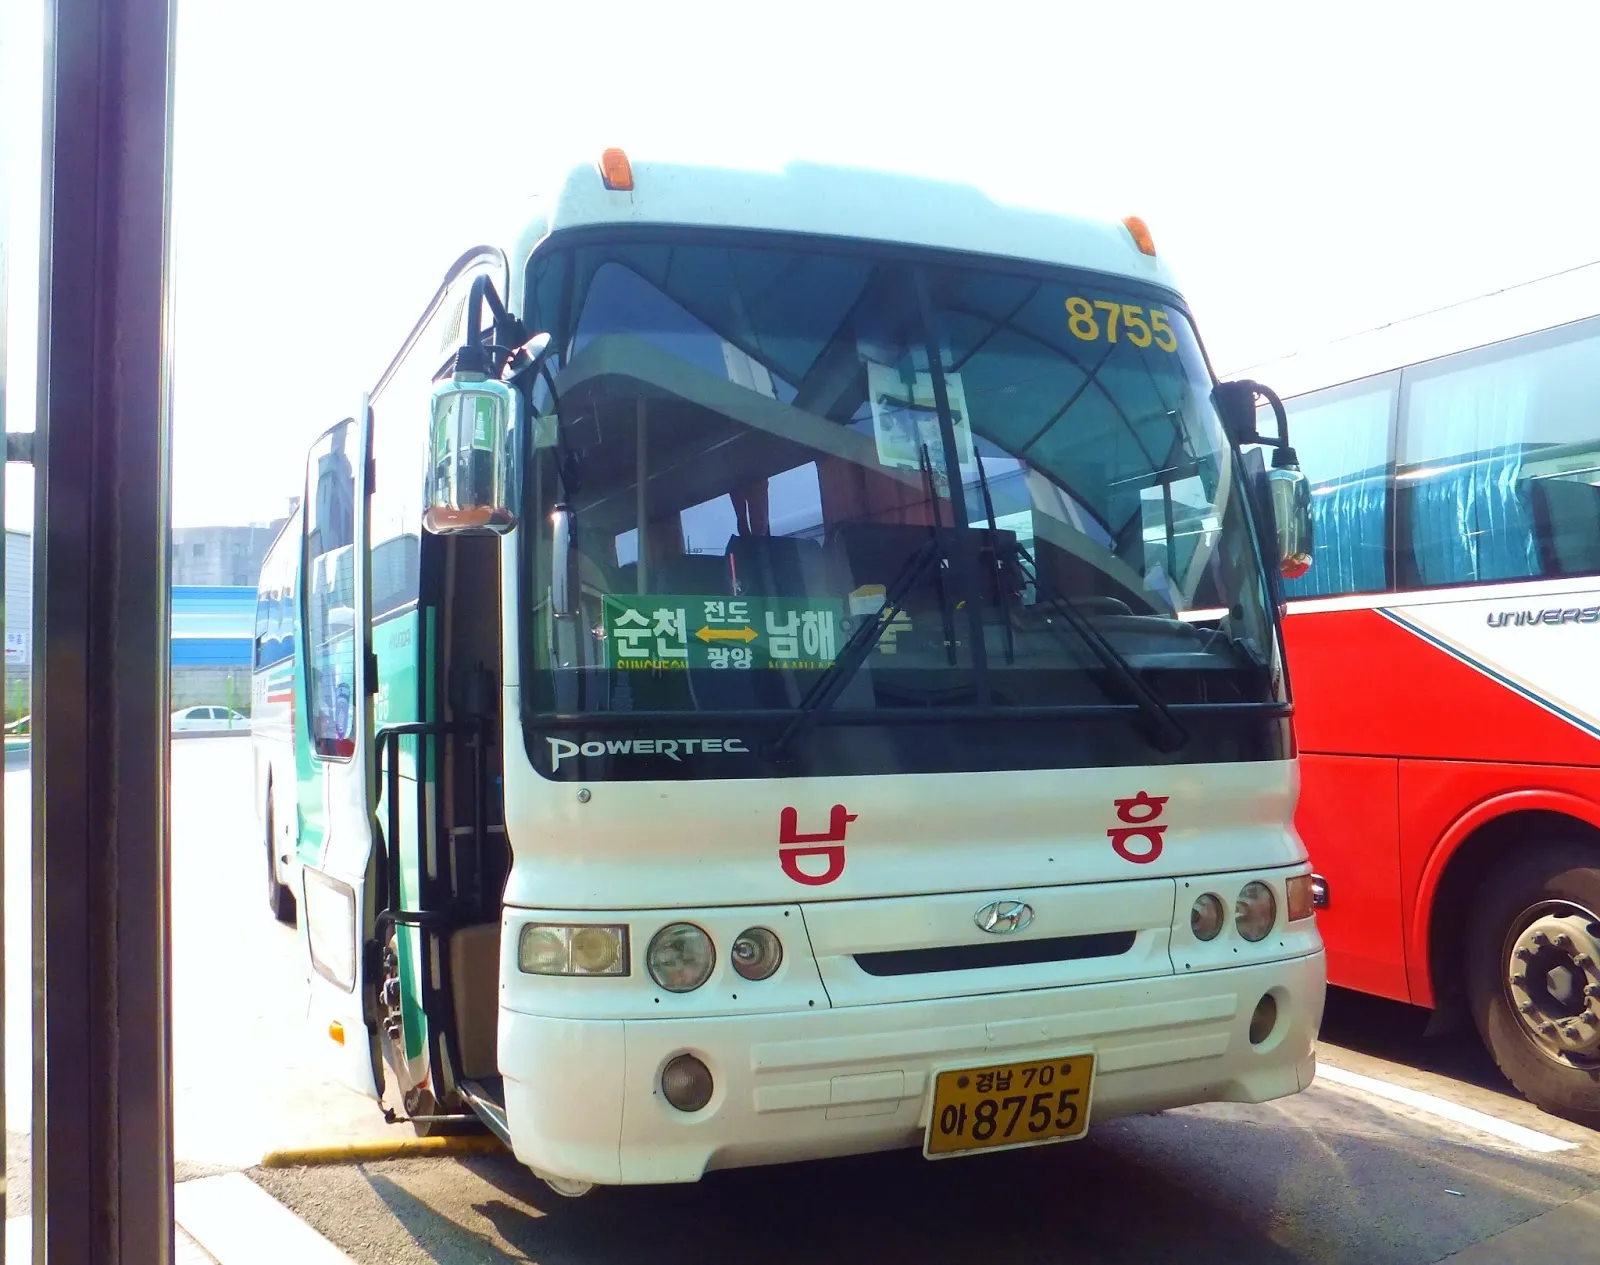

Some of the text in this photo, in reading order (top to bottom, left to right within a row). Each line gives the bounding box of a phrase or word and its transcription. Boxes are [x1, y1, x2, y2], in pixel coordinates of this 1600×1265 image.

[1065, 296, 1178, 353] 8755
[703, 601, 750, 622] 전도
[613, 608, 688, 657] 순천
[765, 610, 837, 660] 남해
[707, 647, 753, 669] 광양
[545, 736, 750, 773] POWERTEC
[976, 1065, 1055, 1093] 경남 70
